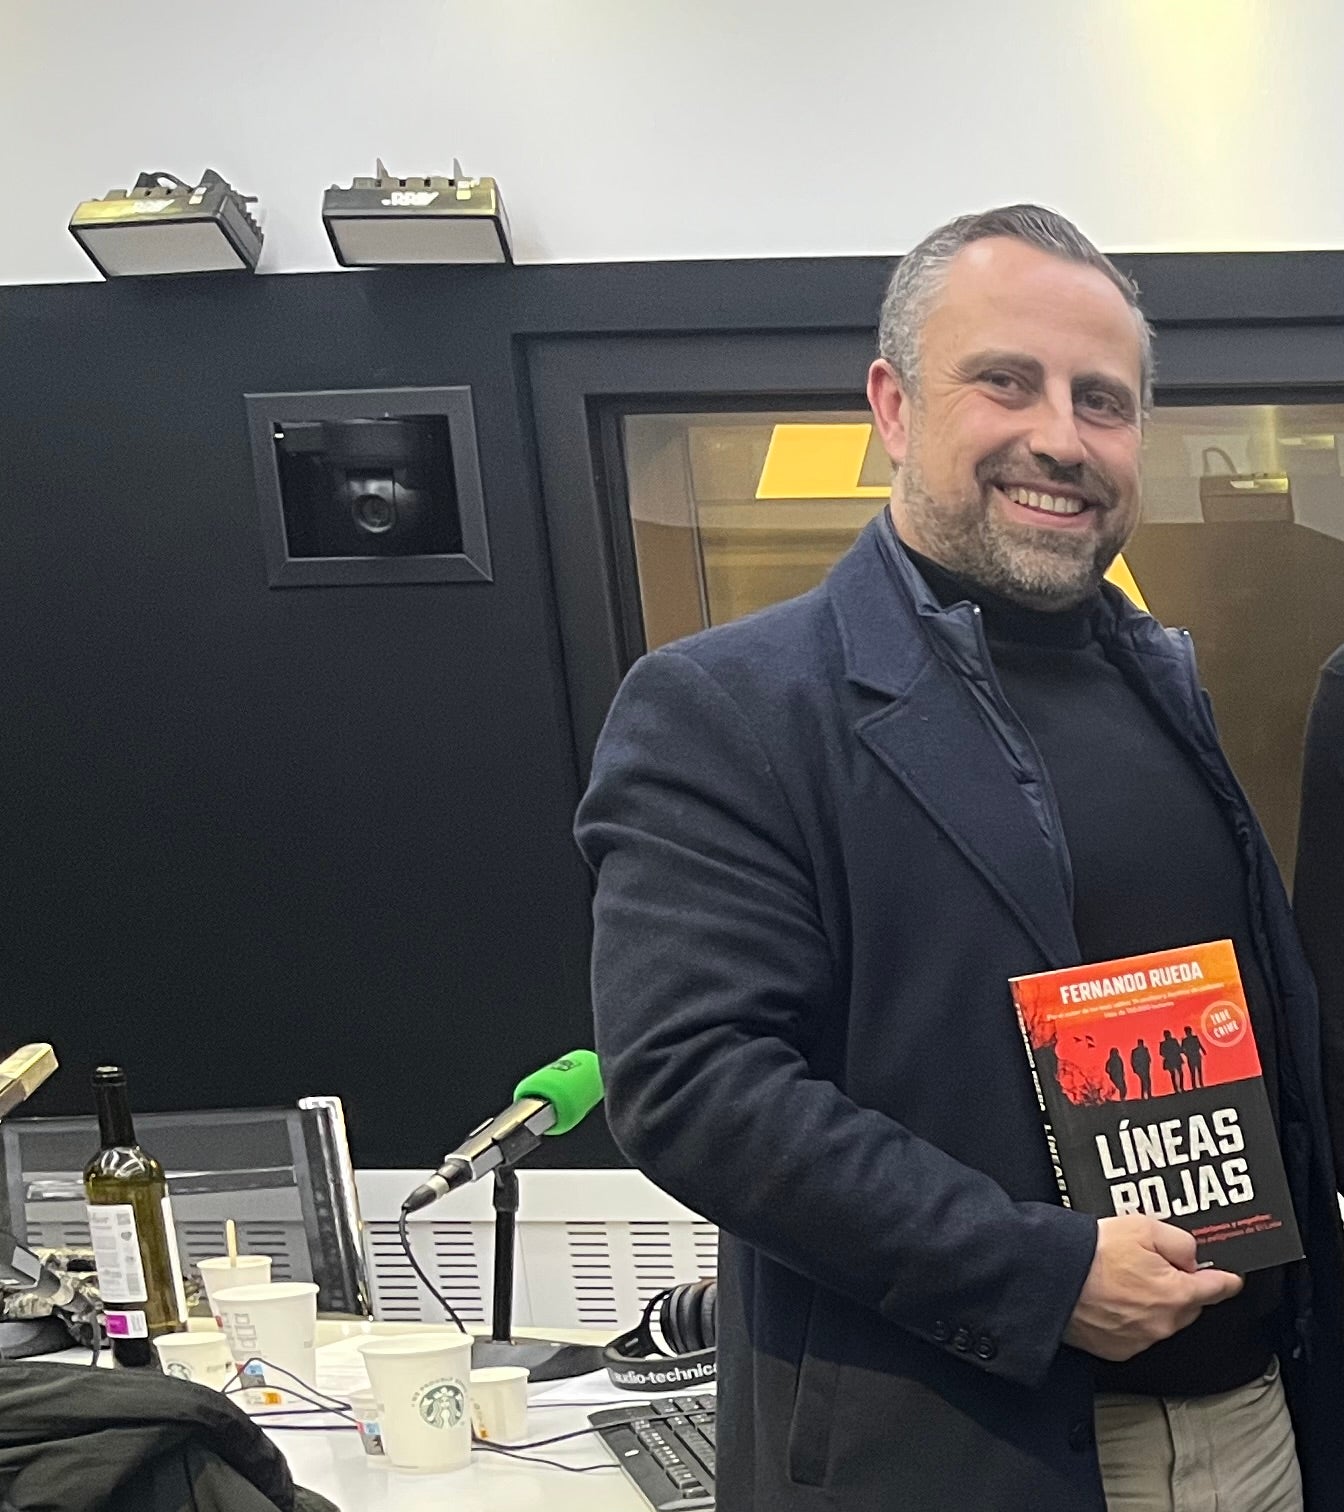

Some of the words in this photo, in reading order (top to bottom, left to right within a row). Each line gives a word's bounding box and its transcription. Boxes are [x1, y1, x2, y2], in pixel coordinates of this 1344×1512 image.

[1059, 971, 1148, 1005] FERNANDO
[1148, 960, 1204, 988] RUEDA
[1095, 1107, 1245, 1180] LÍNEAS
[1110, 1157, 1254, 1222] ROJAS
